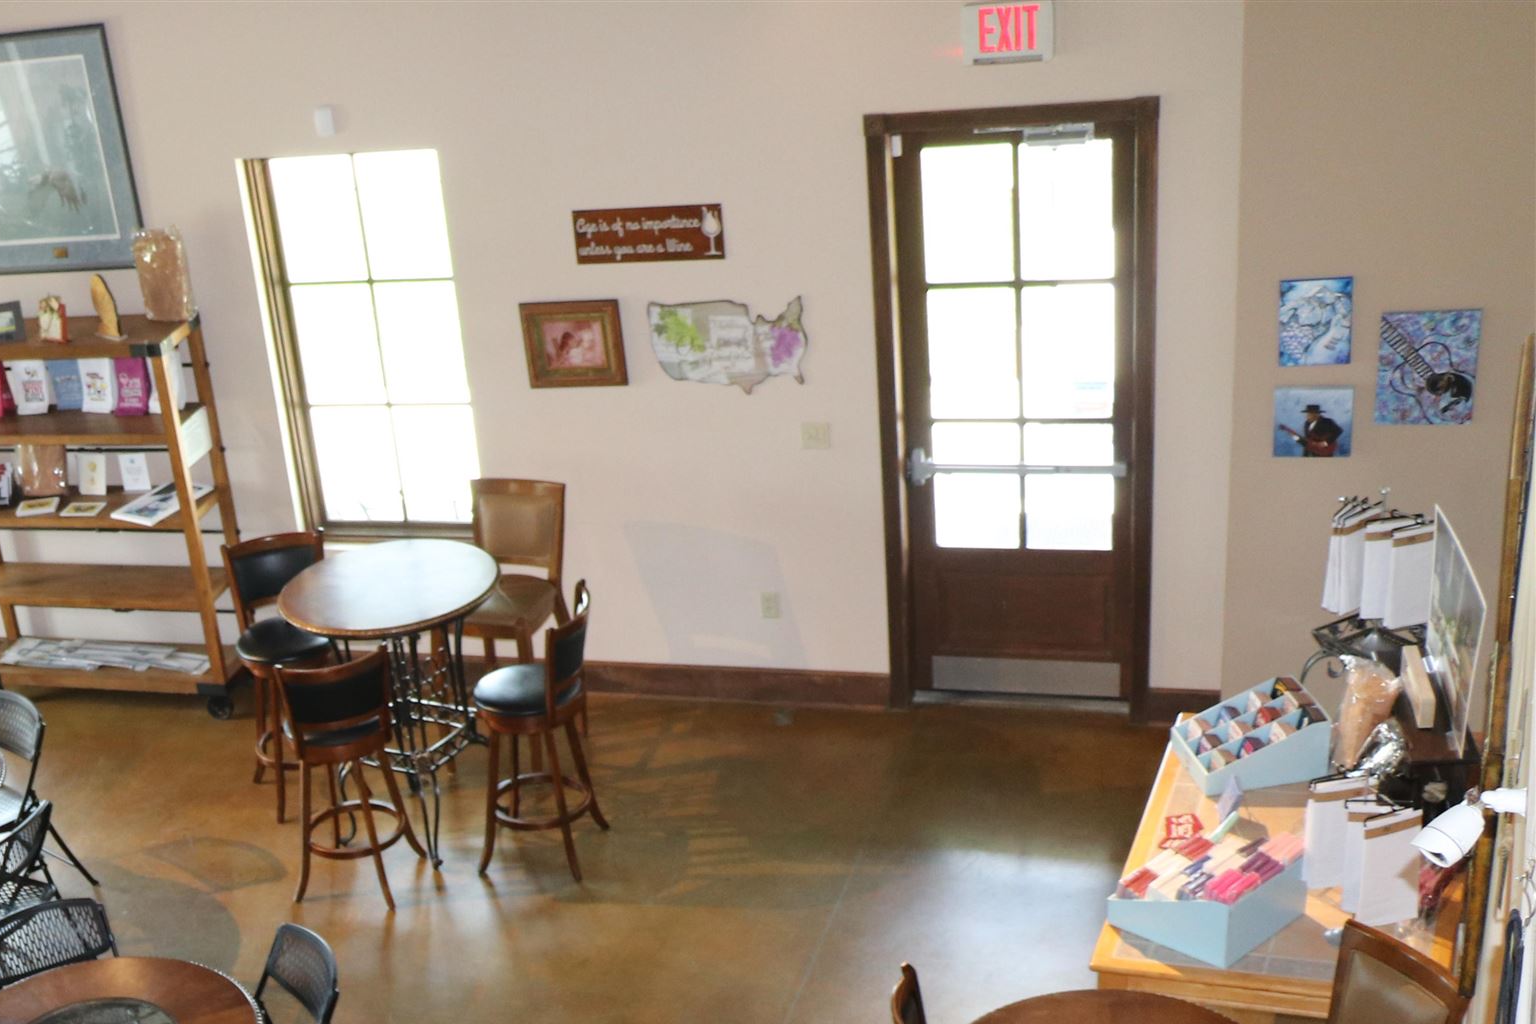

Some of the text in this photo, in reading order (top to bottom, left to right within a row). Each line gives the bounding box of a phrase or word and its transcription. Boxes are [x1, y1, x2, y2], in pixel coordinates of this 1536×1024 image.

[978, 4, 1040, 53] EXIT
[641, 215, 701, 235] importance
[614, 245, 634, 261] you
[636, 244, 656, 253] are
